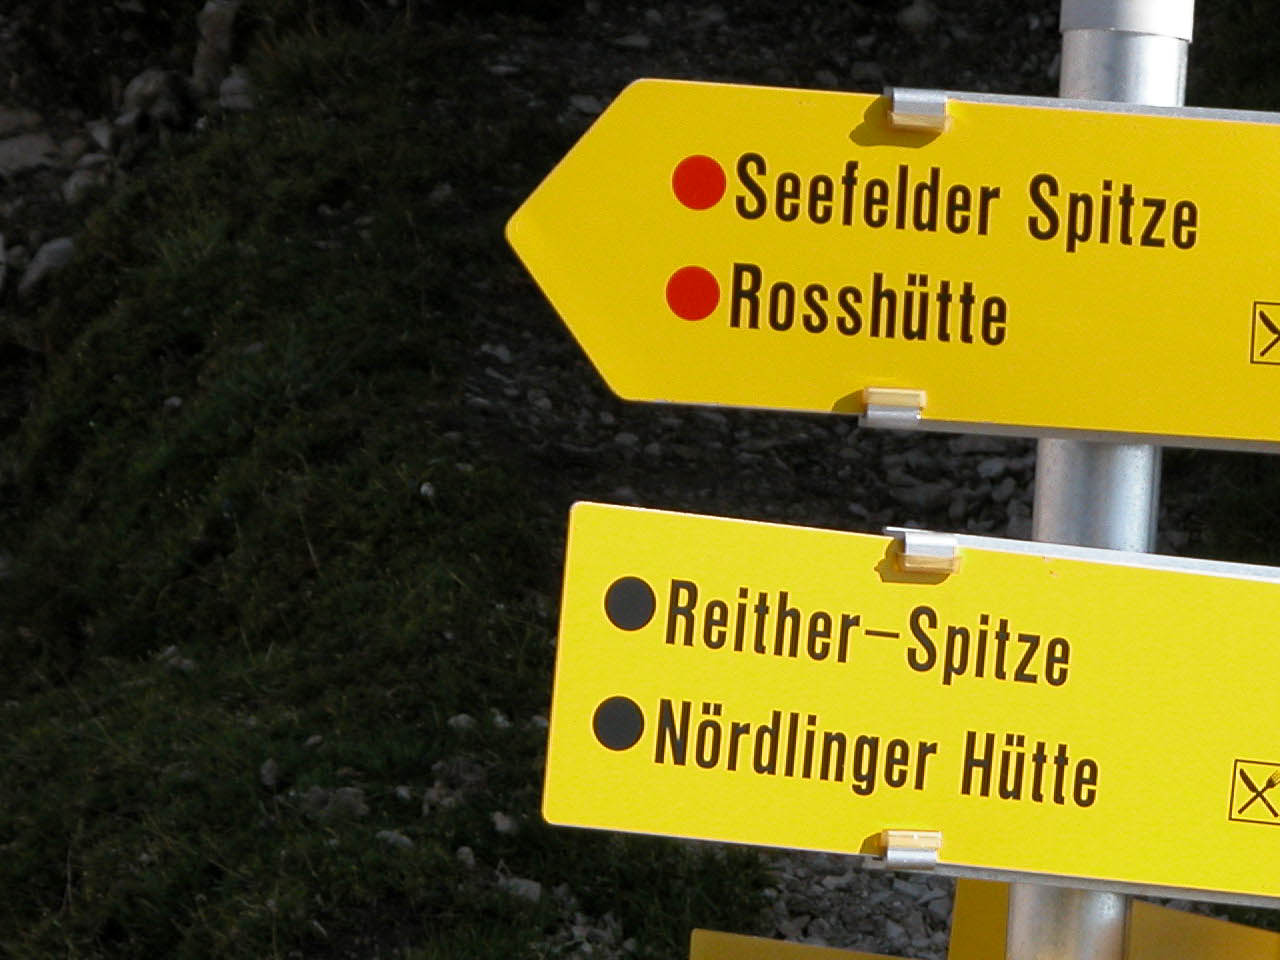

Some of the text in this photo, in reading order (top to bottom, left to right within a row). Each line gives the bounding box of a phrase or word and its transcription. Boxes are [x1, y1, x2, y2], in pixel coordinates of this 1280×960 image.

[734, 151, 1002, 237] Seefelder
[1027, 173, 1202, 254] Spitze
[729, 261, 1008, 347] Rosshütte
[653, 698, 939, 797] Nördlinger
[960, 729, 1099, 809] Hütte
